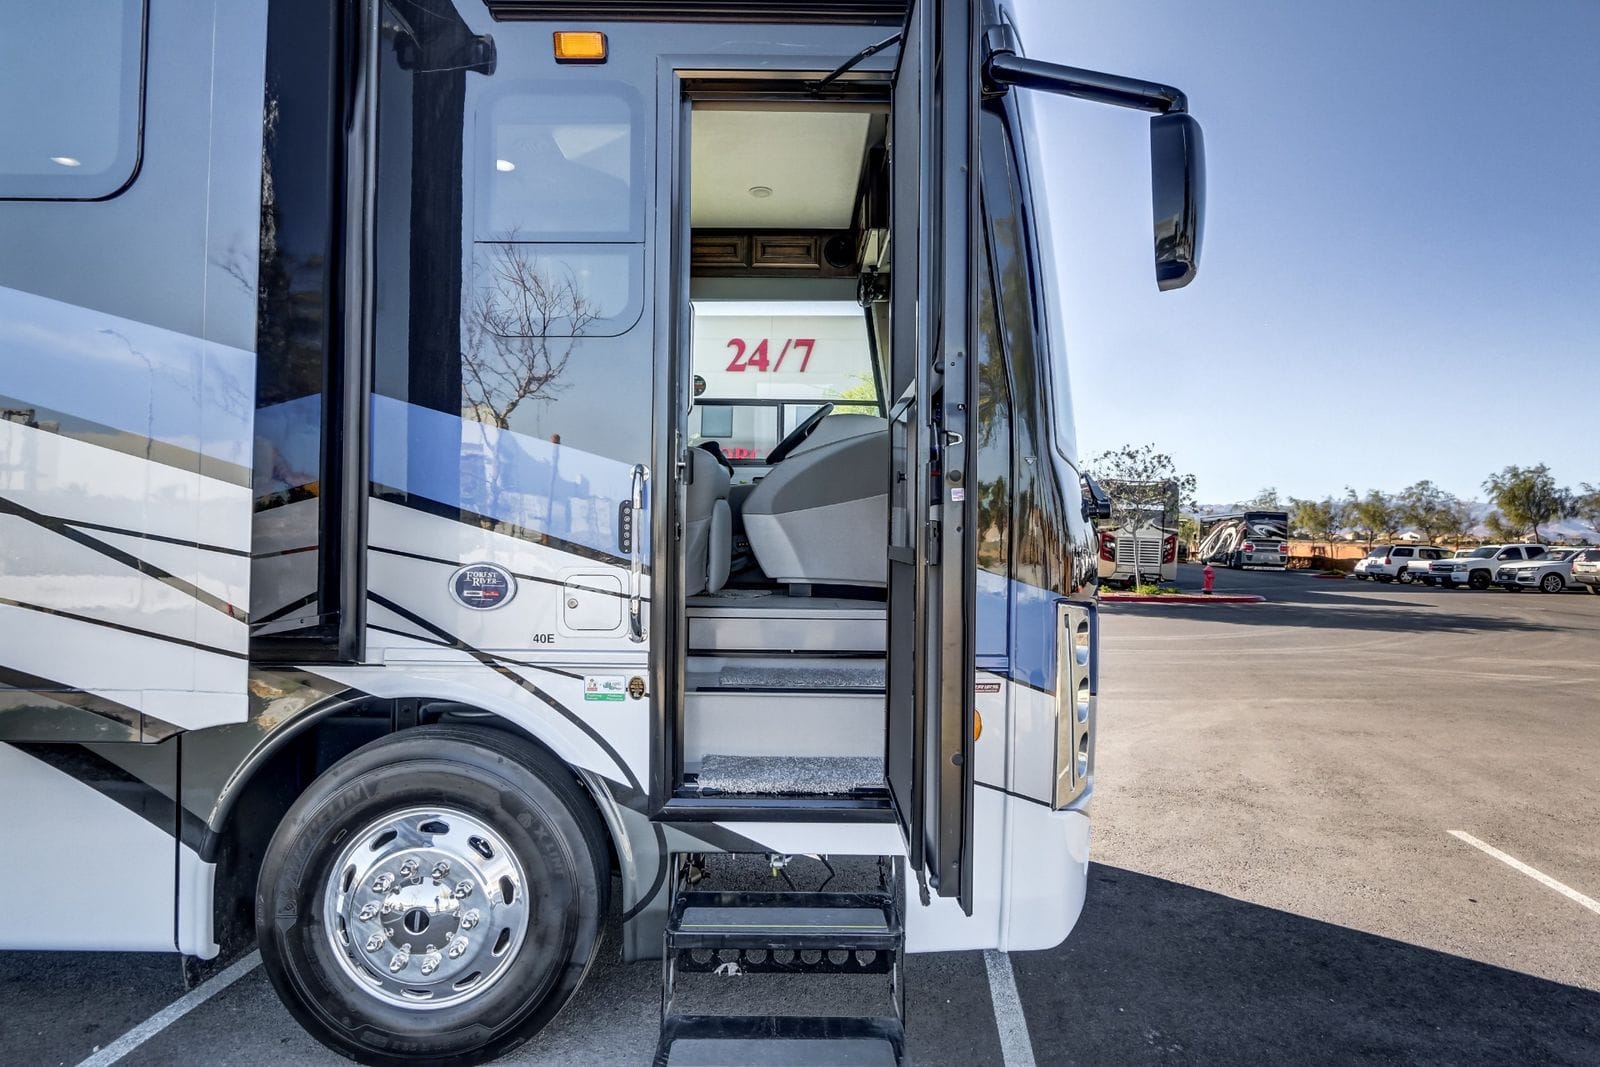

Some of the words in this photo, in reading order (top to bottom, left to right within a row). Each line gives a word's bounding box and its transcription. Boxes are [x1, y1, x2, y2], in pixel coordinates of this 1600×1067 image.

[726, 337, 816, 373] 24/7
[465, 571, 498, 581] FOREST
[472, 577, 497, 587] RIVER
[532, 633, 555, 644] 40E
